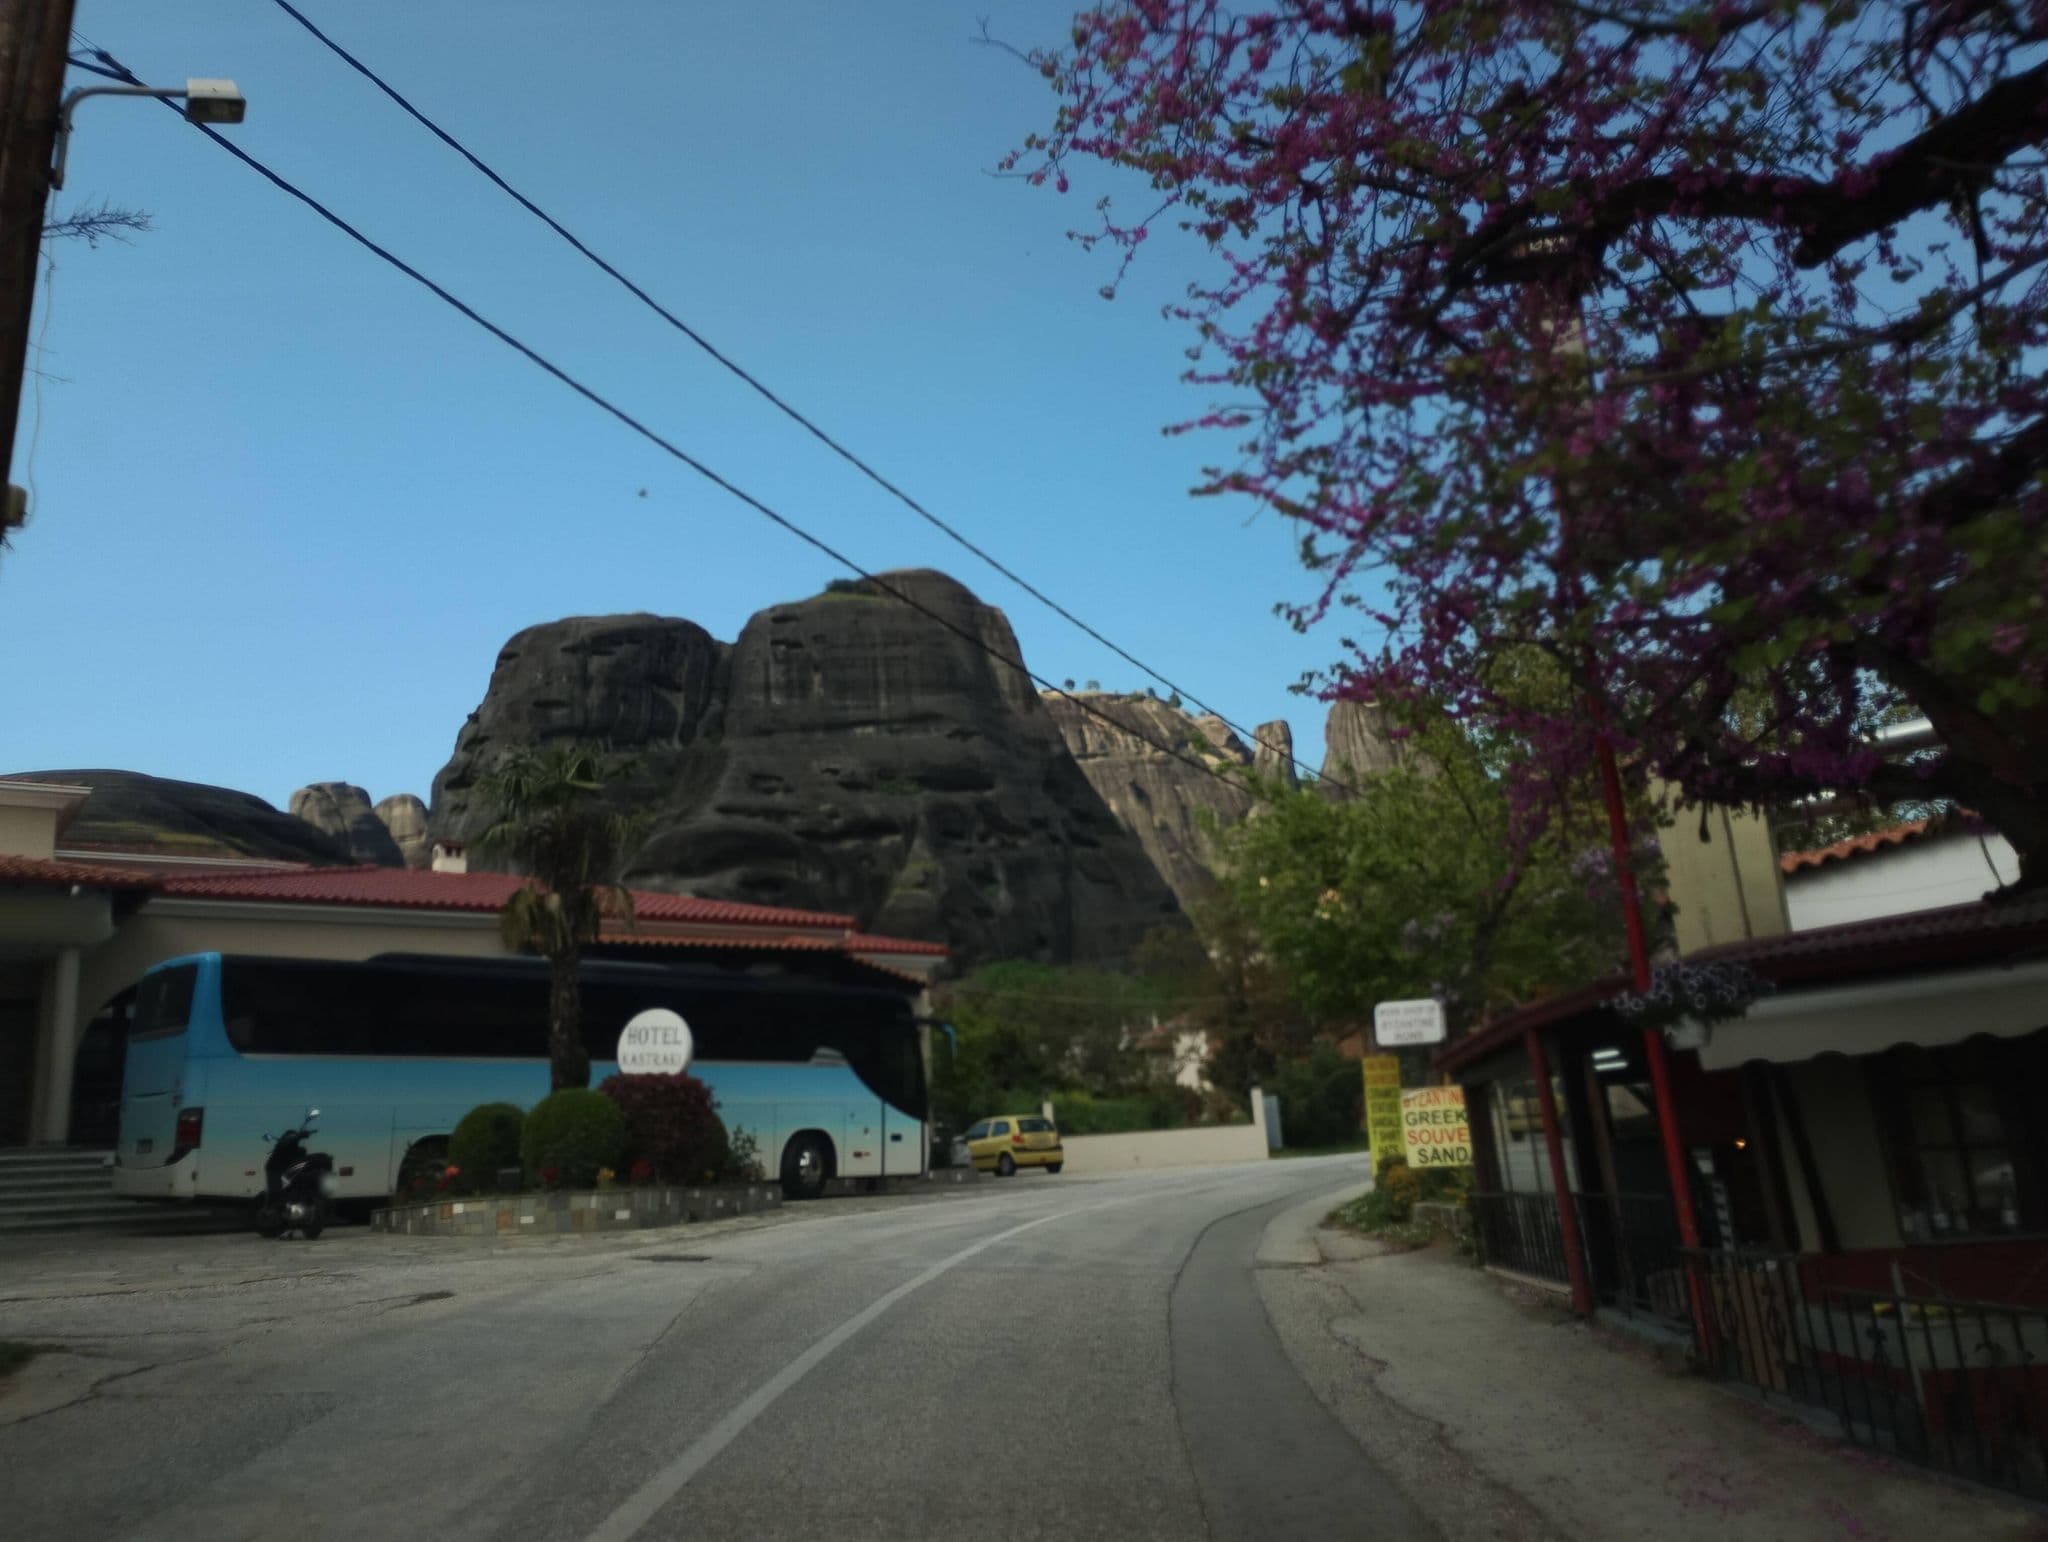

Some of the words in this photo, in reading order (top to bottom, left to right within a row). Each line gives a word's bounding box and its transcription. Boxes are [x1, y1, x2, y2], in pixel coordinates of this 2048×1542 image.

[628, 1025, 682, 1045] HOTEL
[1405, 1109, 1468, 1126] GREEK
[1407, 1127, 1469, 1145] SOUVE
